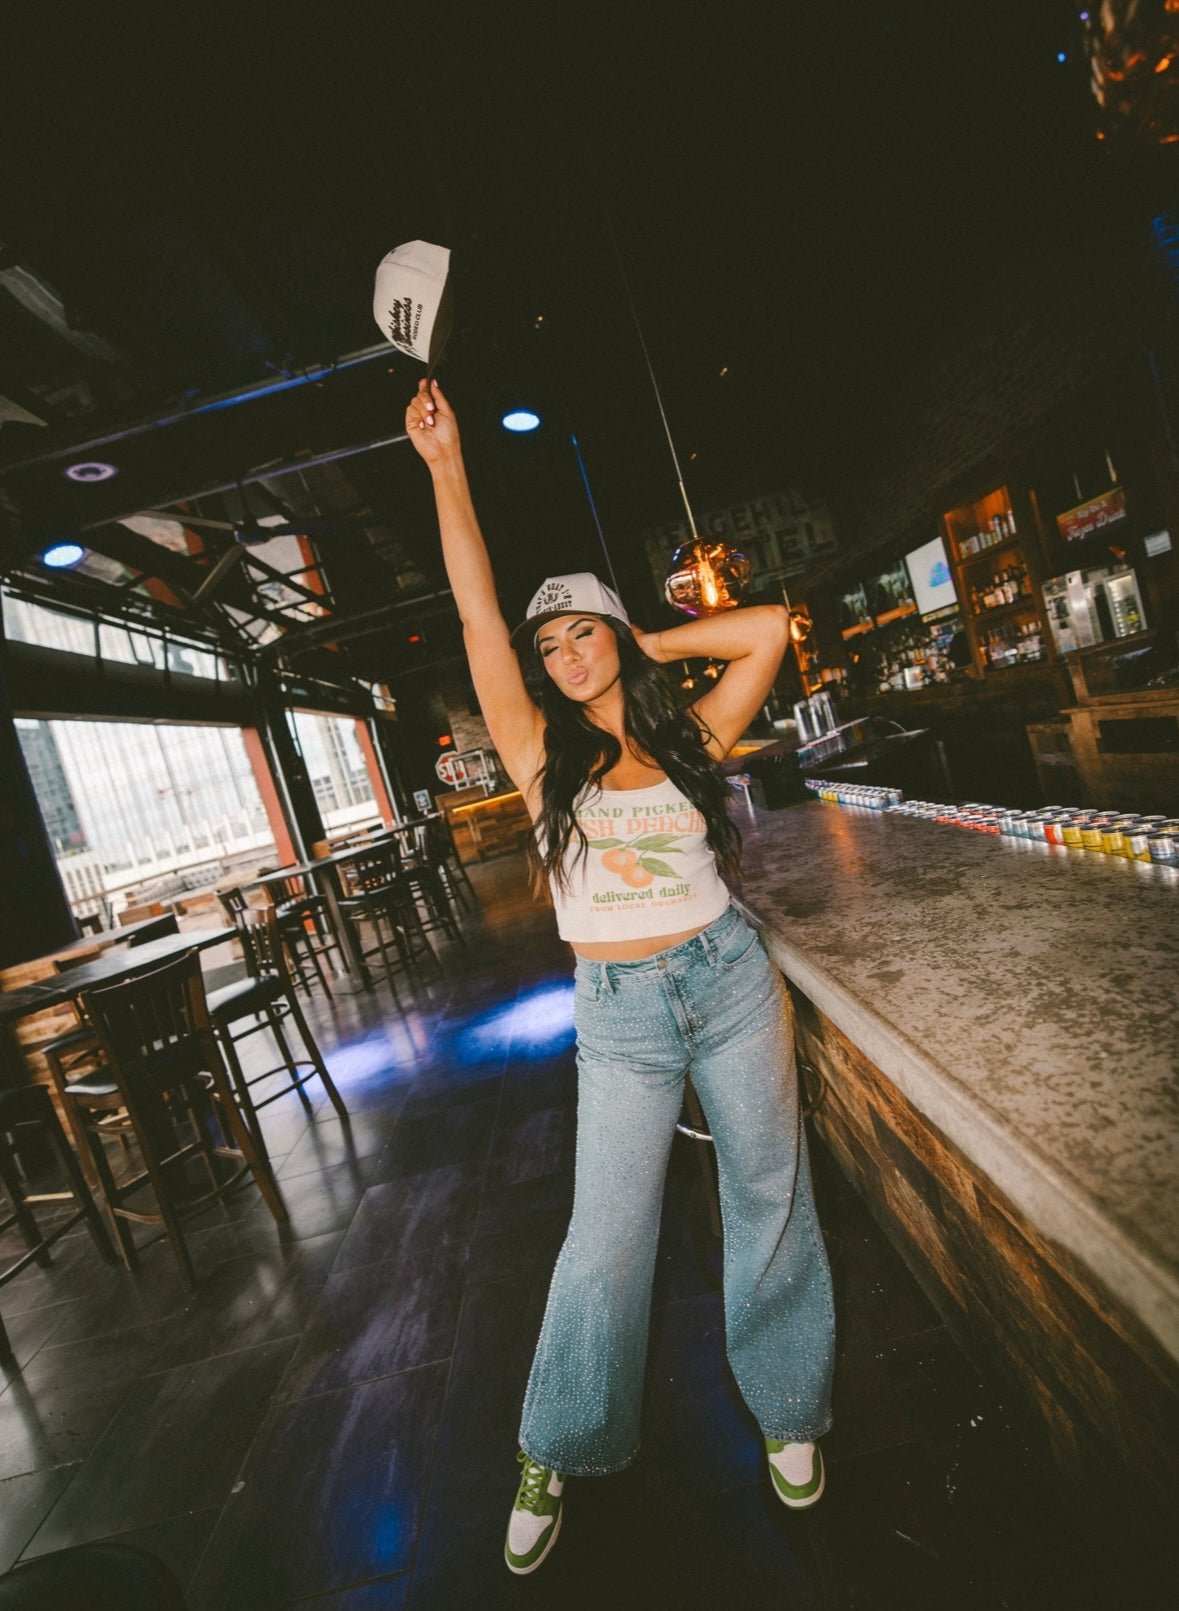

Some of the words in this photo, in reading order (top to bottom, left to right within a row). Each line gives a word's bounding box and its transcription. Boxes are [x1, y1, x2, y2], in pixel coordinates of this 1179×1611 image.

[415, 304, 423, 320] CLUB
[632, 801, 696, 818] PICKE
[592, 888, 653, 904] delivered
[659, 883, 690, 897] daily
[617, 902, 645, 911] LOCAL
